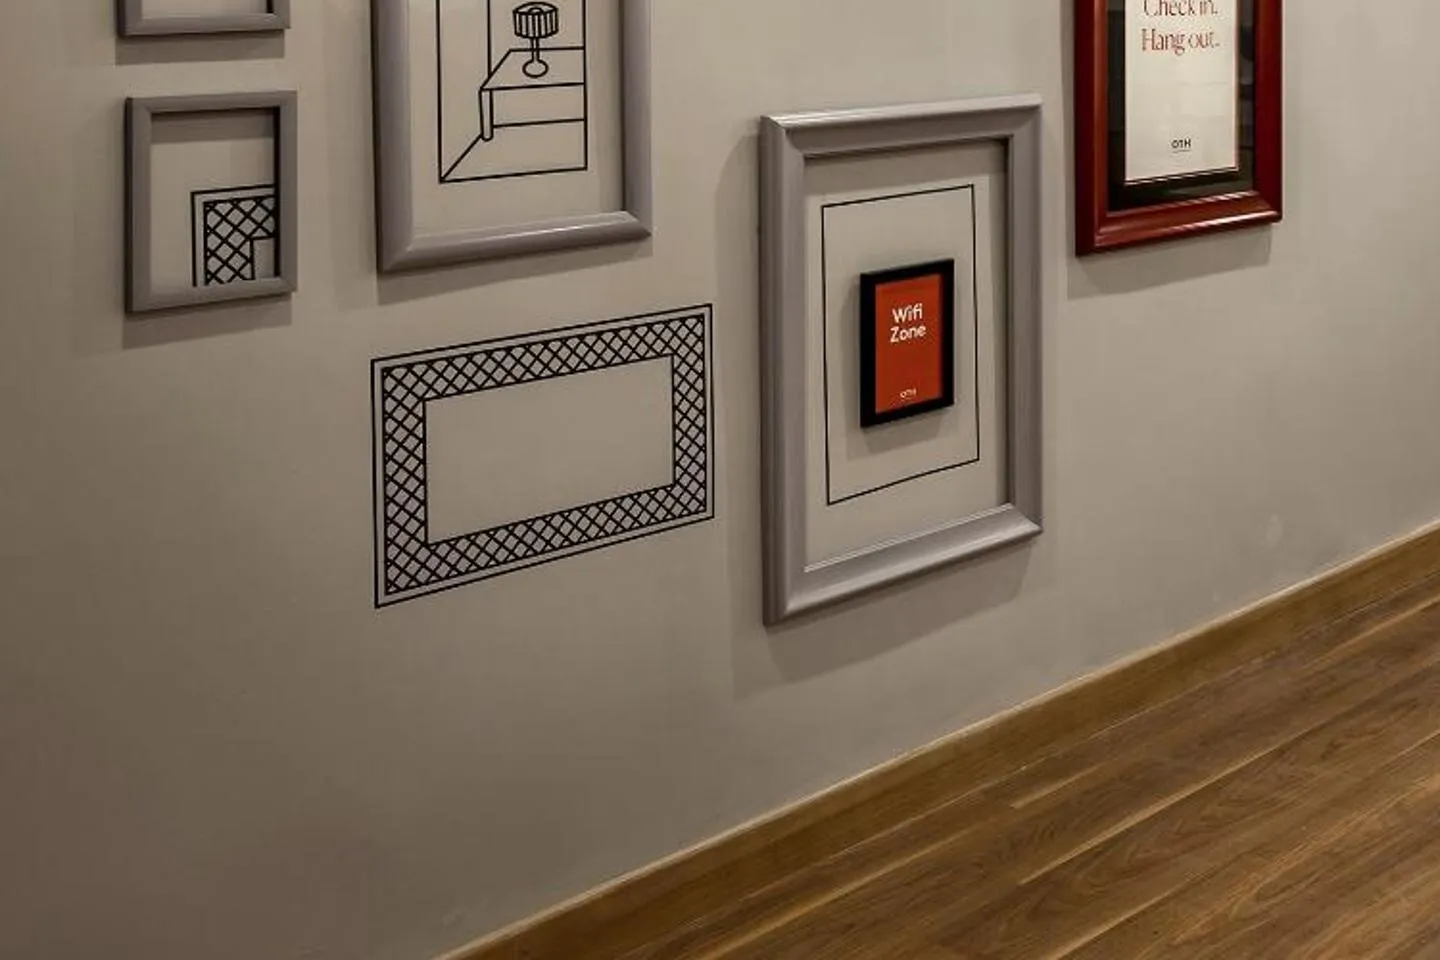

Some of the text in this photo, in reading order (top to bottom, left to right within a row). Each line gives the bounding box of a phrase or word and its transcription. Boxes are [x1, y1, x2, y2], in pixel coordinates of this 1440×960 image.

[1141, 28, 1220, 57] Hang out.
[892, 303, 923, 324] Wifi
[890, 325, 927, 343] Zone
